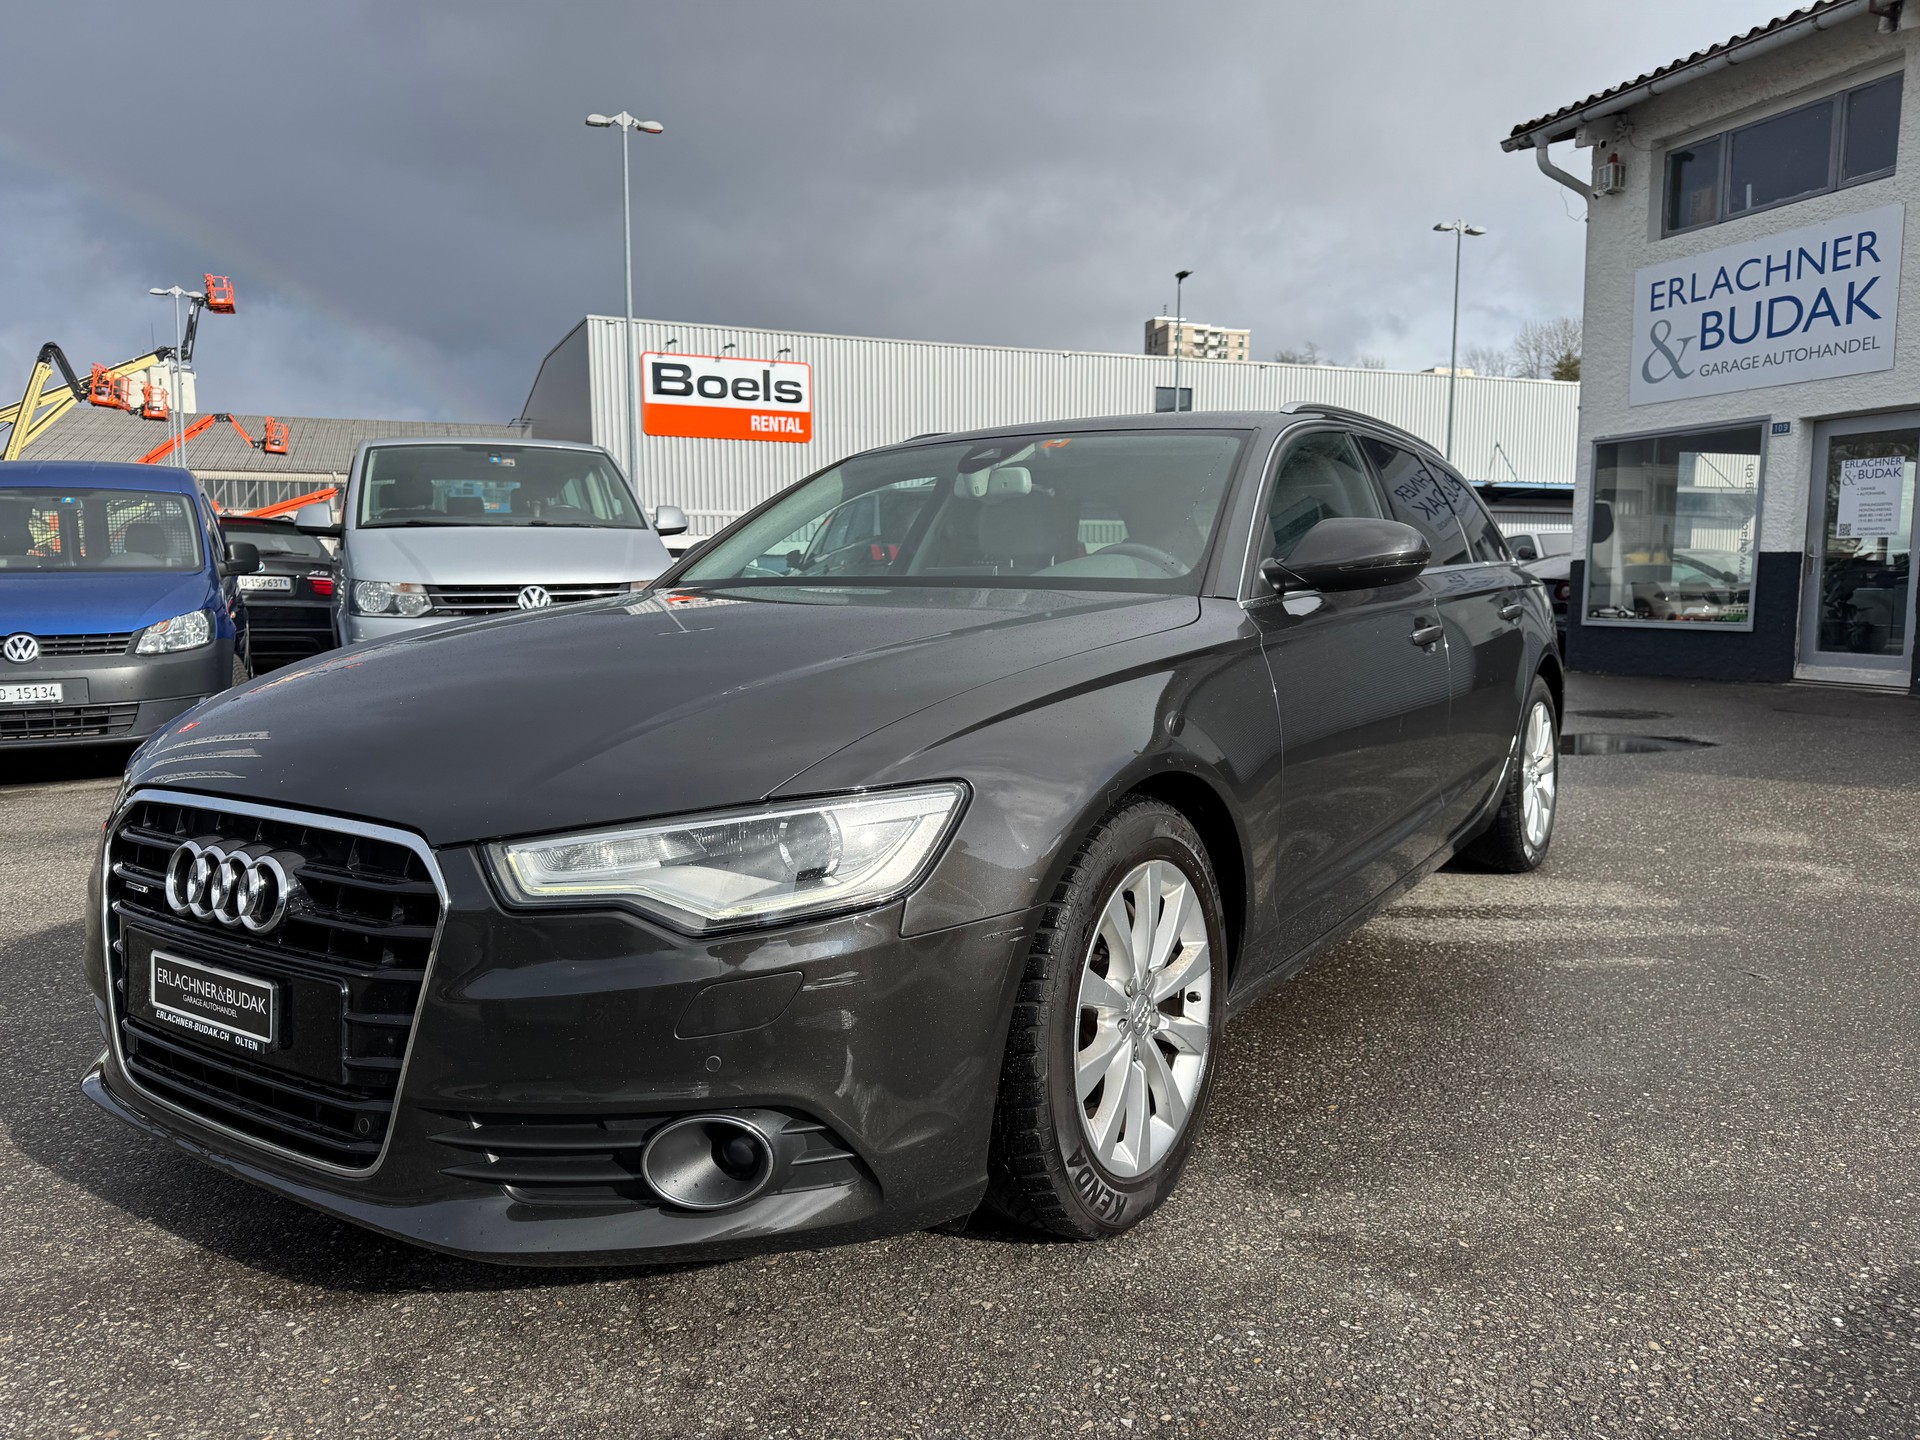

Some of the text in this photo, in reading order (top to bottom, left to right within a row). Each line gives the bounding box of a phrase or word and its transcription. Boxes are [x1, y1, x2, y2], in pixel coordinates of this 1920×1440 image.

[1650, 231, 1881, 312] ERLACHNER
[1641, 276, 1882, 384] & BUDAK
[1699, 335, 1880, 377] GARAGE AUTOHANDEL
[652, 362, 803, 404] Boels
[751, 415, 804, 433] RENTAL
[1774, 423, 1788, 433] 109
[1842, 467, 1902, 486] & BUDAK
[1844, 457, 1902, 469] ERLACHNER
[183, 994, 238, 1018] GARAGE AUTOHANDEL
[155, 1009, 258, 1051] ERLACHNER-BUDAK.CH OLTEN
[1066, 1144, 1128, 1222] KENDA
